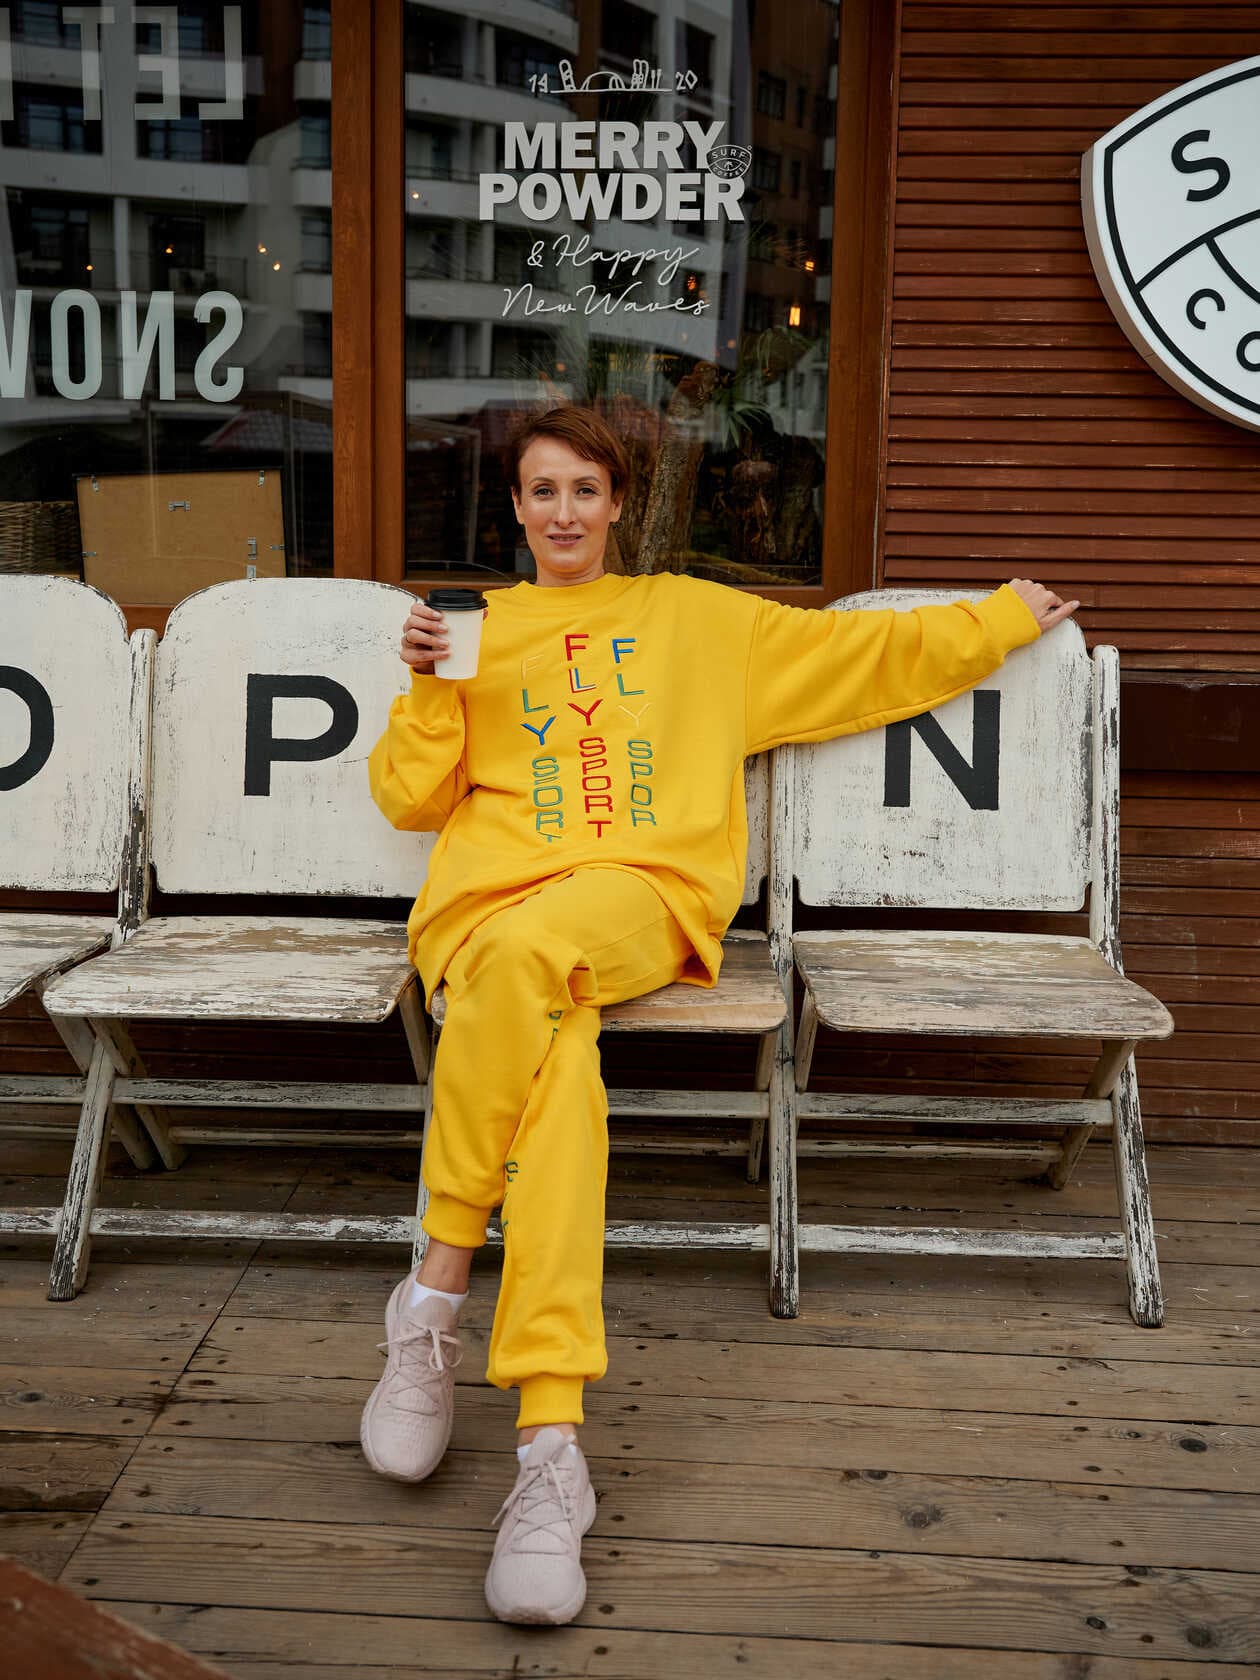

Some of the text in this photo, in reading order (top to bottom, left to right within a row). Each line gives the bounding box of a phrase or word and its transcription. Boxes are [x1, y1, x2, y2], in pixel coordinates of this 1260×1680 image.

[528, 73, 549, 94] 14
[504, 120, 725, 169] MERRY
[711, 147, 747, 159] SURF
[479, 172, 745, 221] POWDER
[527, 234, 700, 285] & Happy
[502, 281, 711, 317] New Waves
[611, 637, 652, 729] FLY
[563, 633, 614, 838] FLY SPORT
